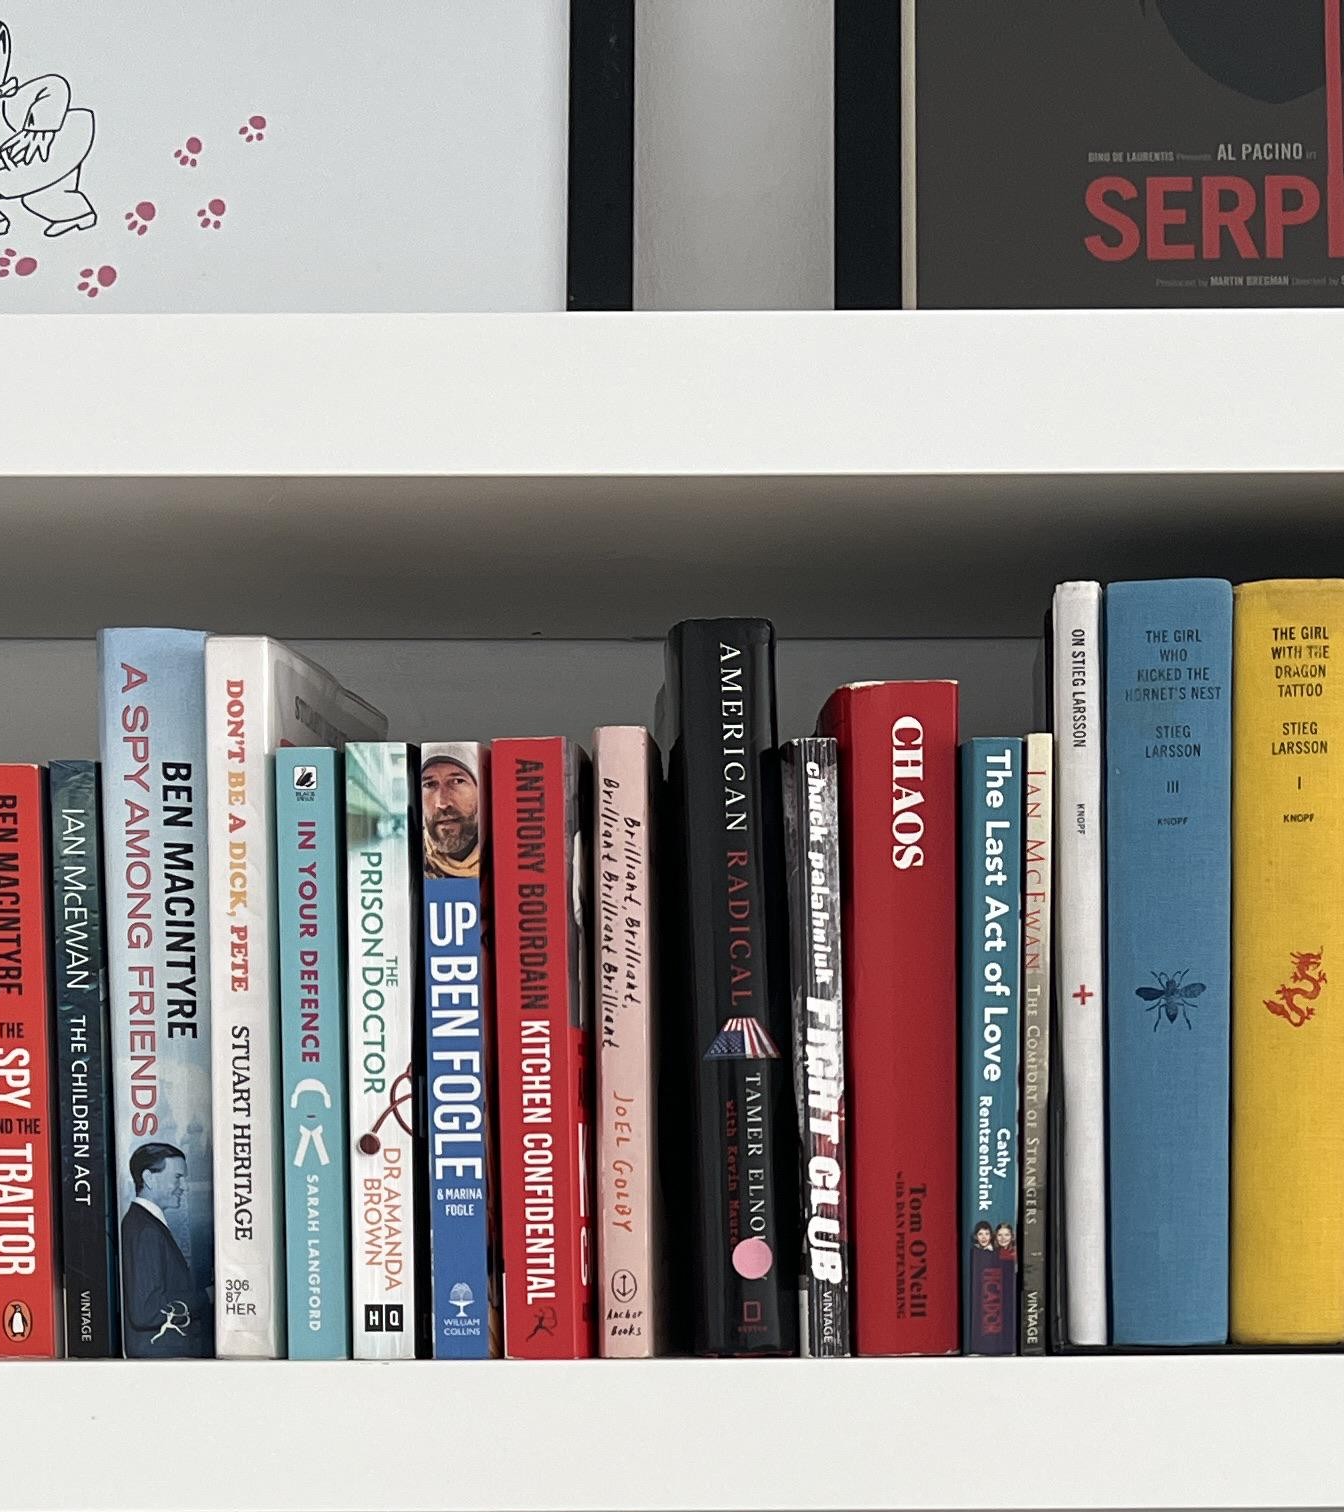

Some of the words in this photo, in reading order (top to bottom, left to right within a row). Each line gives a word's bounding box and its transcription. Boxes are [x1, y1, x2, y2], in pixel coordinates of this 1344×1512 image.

[1217, 144, 1235, 160] AL
[1241, 144, 1302, 161] PACINO
[1072, 629, 1085, 646] ON
[1272, 627, 1295, 641] THE
[1300, 627, 1329, 640] GIRL
[120, 662, 148, 694] A
[1072, 651, 1086, 684] STIEG
[1274, 664, 1326, 679] DRAGON
[1278, 684, 1324, 698] TATTOO
[718, 641, 747, 832] AMERICAN
[1073, 689, 1087, 748] LARSSON
[1282, 721, 1318, 736] STIEG
[120, 705, 151, 792] SPY
[1271, 740, 1328, 755] LARSSON
[890, 716, 925, 870] CHAOS
[984, 750, 1012, 809] The
[297, 820, 314, 845] IN
[1283, 814, 1315, 823] KNOPF
[124, 799, 153, 950] AMONG
[984, 816, 1010, 887] Last
[297, 856, 316, 939] YOUR
[984, 896, 1009, 952] Act
[726, 850, 754, 1006] RADICAL
[300, 949, 321, 1064] DEFENCE
[430, 956, 478, 1038] BEN
[984, 958, 1009, 999] of
[127, 965, 158, 1138] FRIENDS
[982, 1005, 1008, 1081] Love
[520, 1020, 551, 1124] KITCHEN
[434, 1051, 482, 1181] FOGLE
[612, 1091, 631, 1150] JOEL
[978, 1095, 991, 1211] Rentzenbrink
[996, 1127, 1010, 1179] Cathy
[437, 1189, 445, 1200] &
[447, 1189, 482, 1200] MARINA
[446, 1204, 475, 1216] FOGLE
[524, 1131, 556, 1304] CONFIDENTIAL
[612, 1158, 634, 1232] GOLBY
[225, 1279, 250, 1292] 306
[225, 1291, 242, 1303] 87
[225, 1303, 257, 1315] HER
[80, 1291, 91, 1342] VINTAGE
